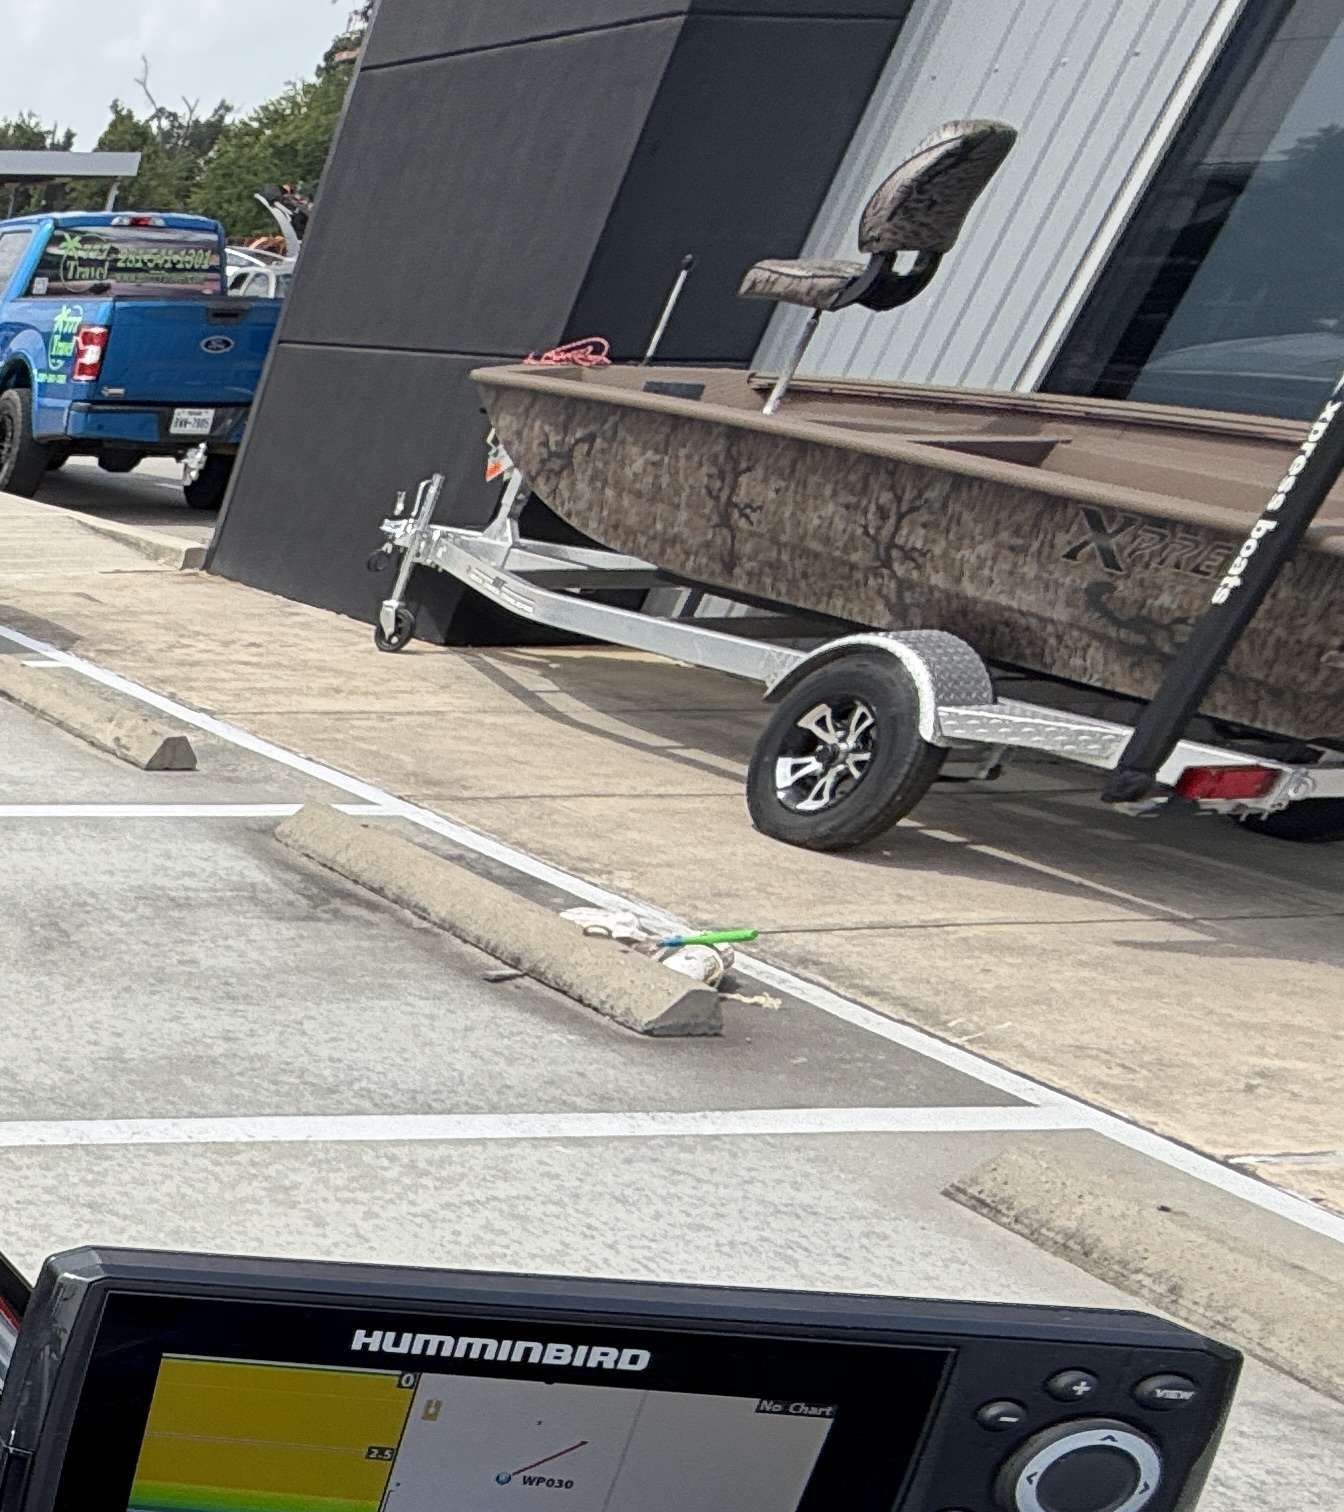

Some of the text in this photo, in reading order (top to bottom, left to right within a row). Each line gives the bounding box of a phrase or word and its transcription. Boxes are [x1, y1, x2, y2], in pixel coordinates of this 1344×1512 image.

[1211, 519, 1279, 605] boats
[350, 1329, 652, 1371] HUMMINBIRD
[400, 1374, 414, 1387] 0
[1154, 1388, 1196, 1400] VIEW
[368, 1448, 393, 1460] 2.5
[522, 1474, 575, 1490] WP030
